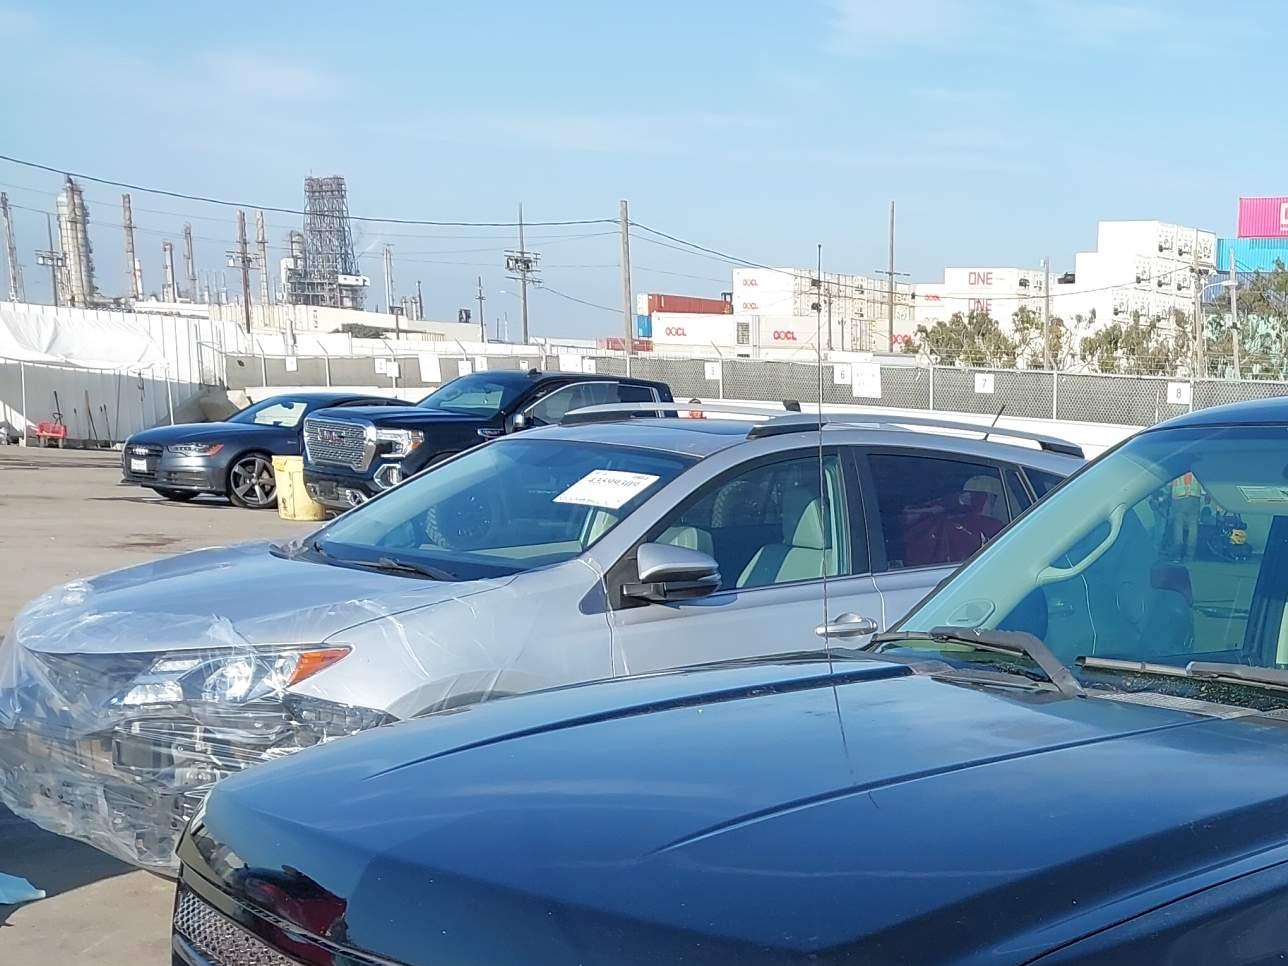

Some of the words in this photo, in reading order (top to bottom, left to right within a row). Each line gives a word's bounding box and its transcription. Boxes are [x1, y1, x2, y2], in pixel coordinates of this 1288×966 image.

[969, 272, 993, 286] ONE
[968, 299, 993, 313] ONE
[665, 326, 688, 337] OOCL
[773, 330, 797, 341] OOCL
[1175, 387, 1182, 399] 8
